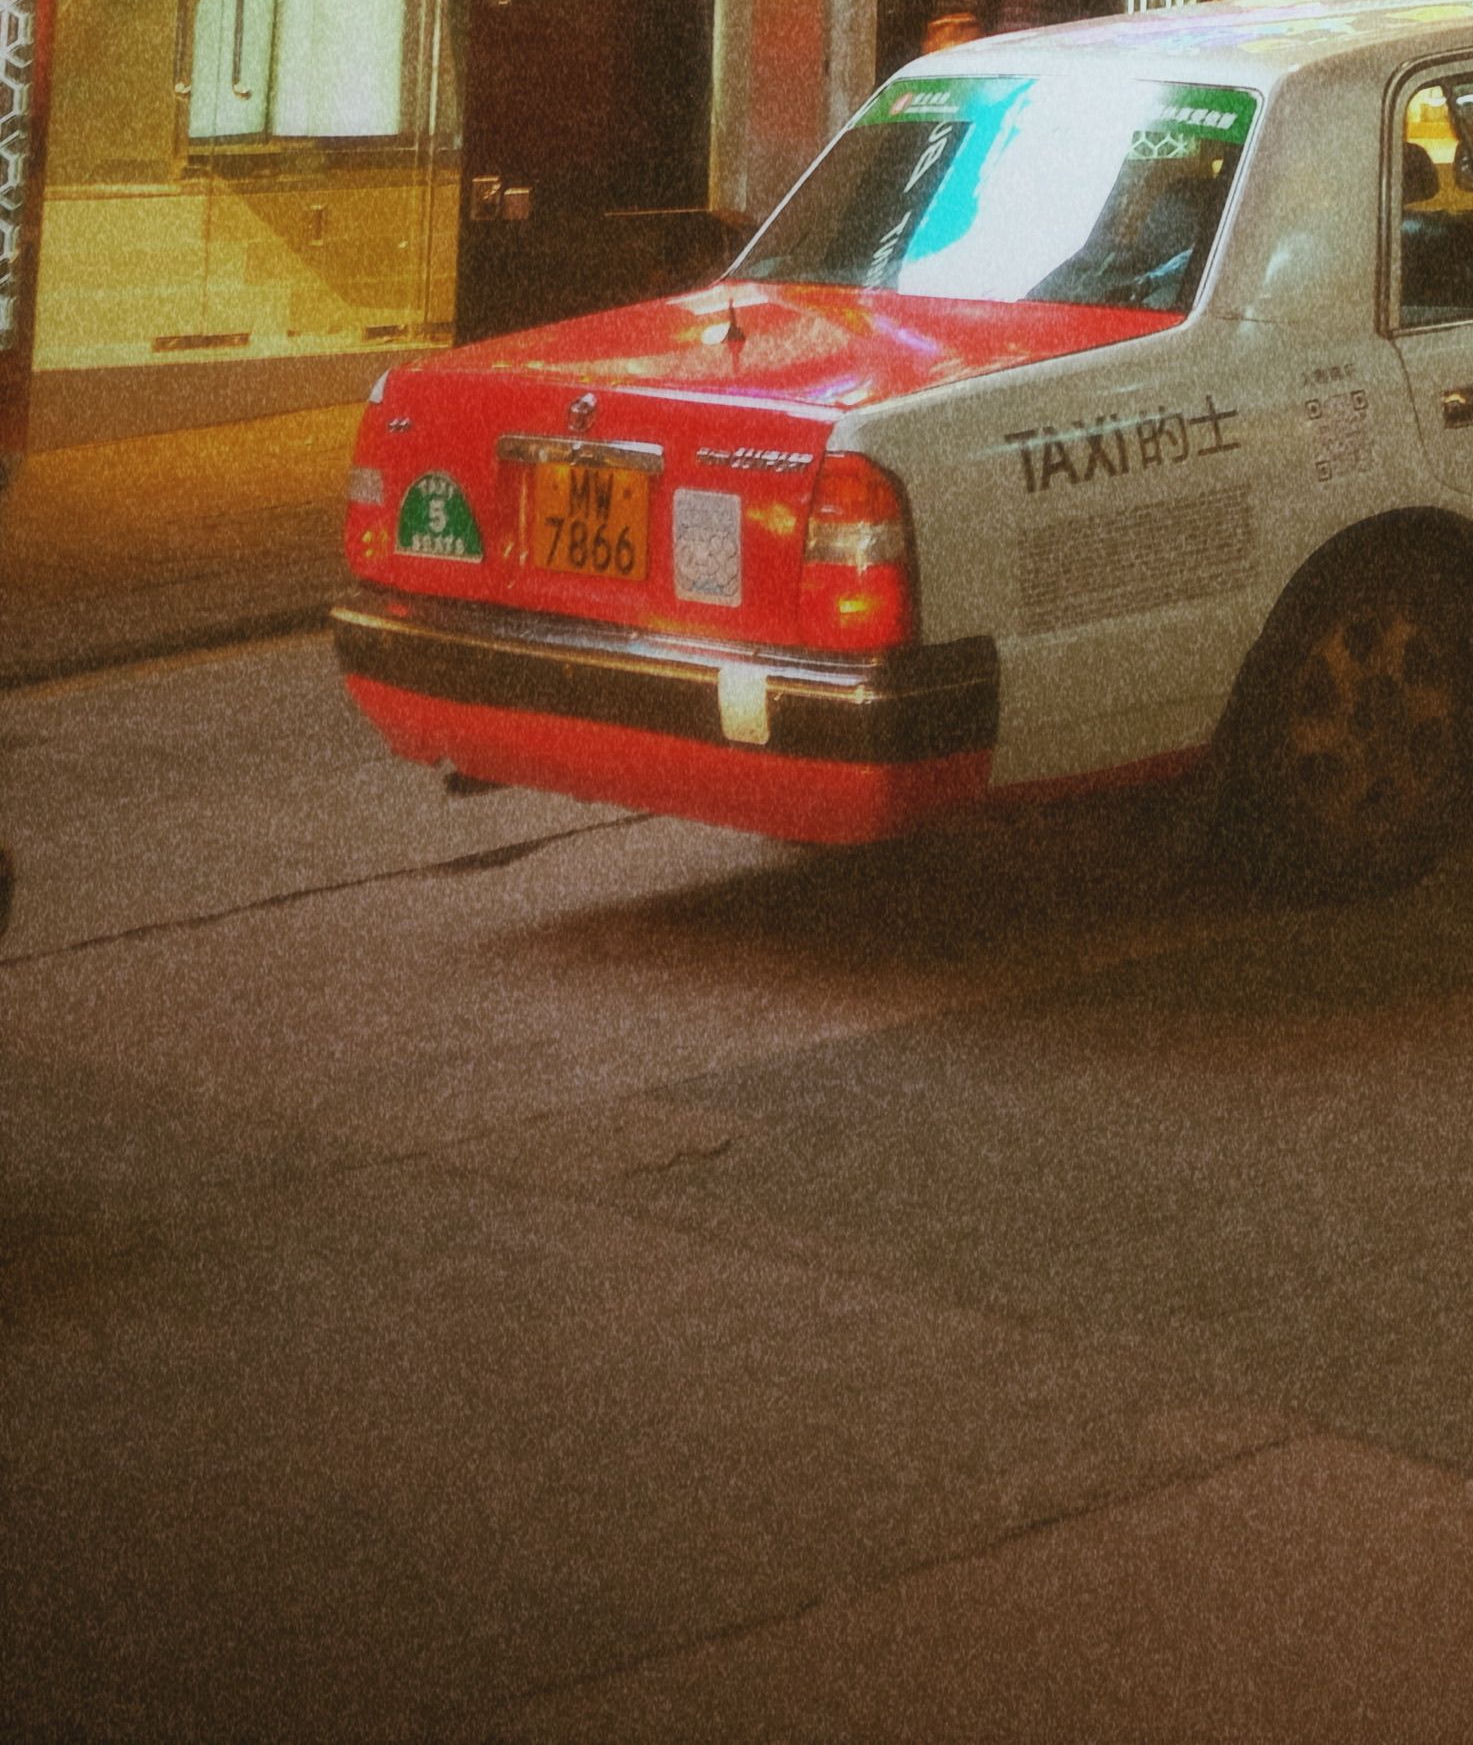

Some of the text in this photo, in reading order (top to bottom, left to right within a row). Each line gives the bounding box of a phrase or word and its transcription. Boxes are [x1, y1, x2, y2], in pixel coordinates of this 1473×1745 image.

[1003, 394, 1242, 494] TAXI 的士
[428, 498, 449, 534] 5
[567, 468, 615, 520] MW
[543, 517, 637, 577] 7866
